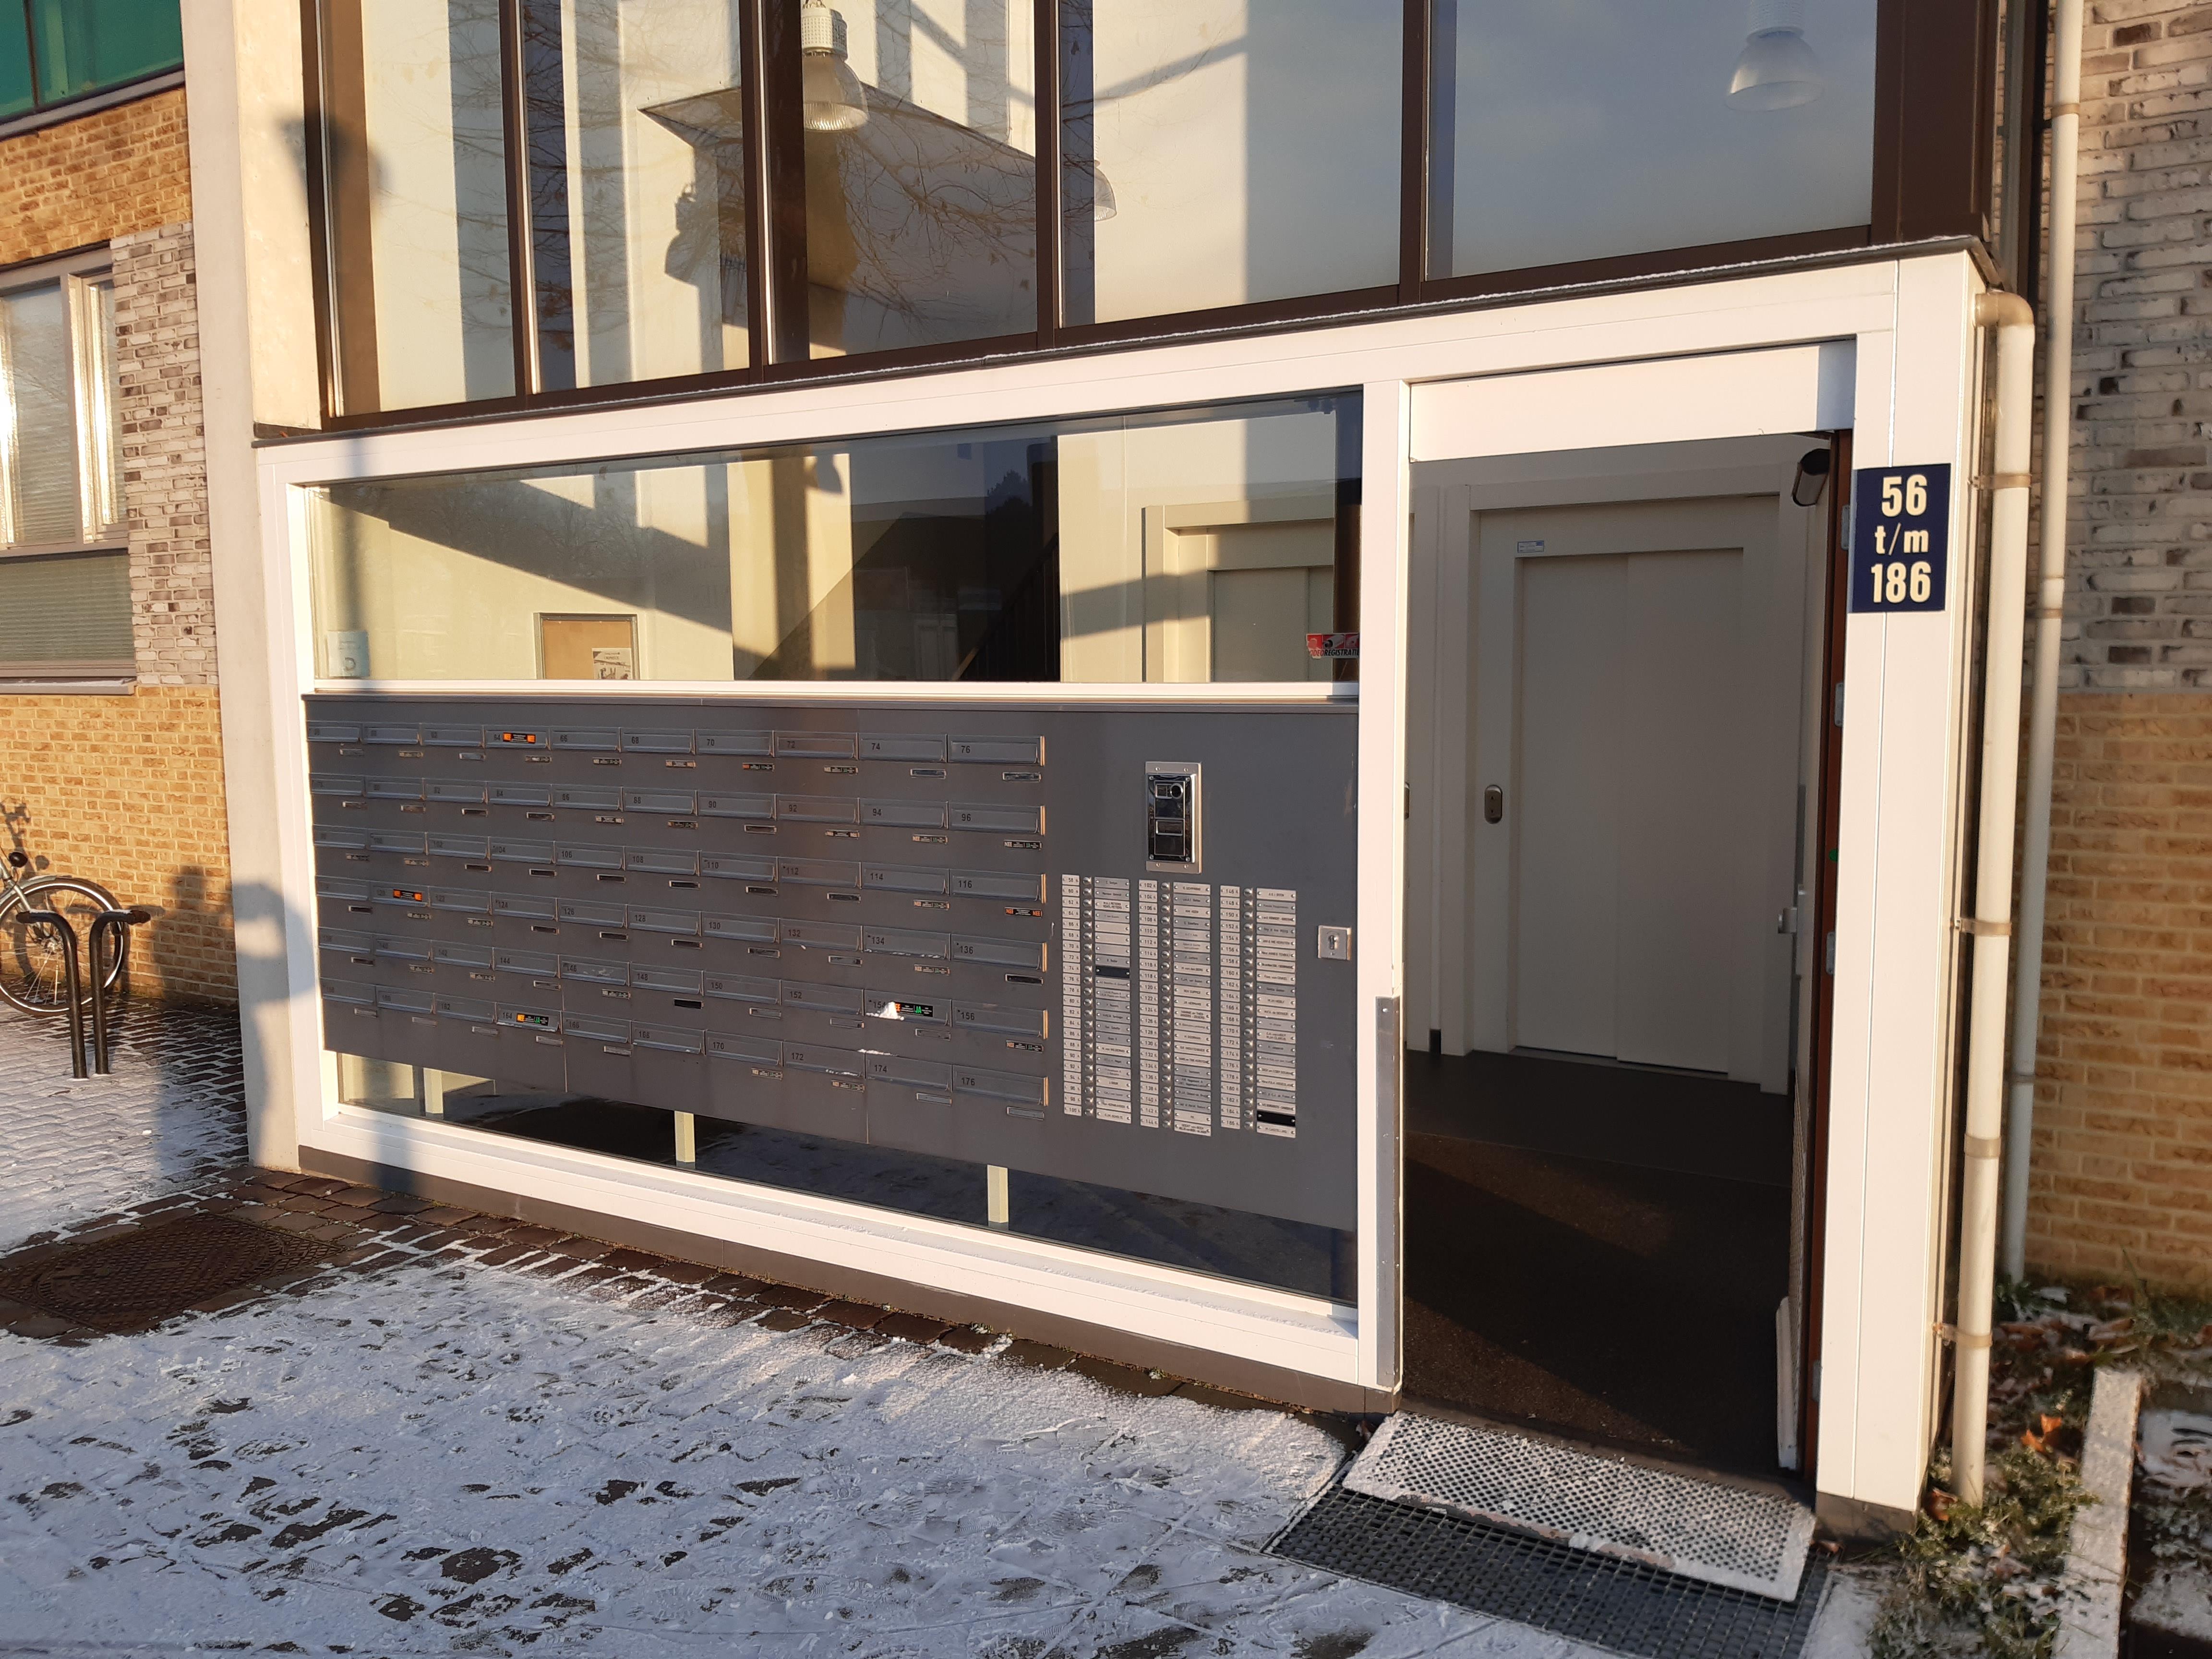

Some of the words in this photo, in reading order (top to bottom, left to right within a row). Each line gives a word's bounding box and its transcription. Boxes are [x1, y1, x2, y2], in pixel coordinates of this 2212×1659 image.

[1881, 473, 1928, 517] 56
[1874, 522, 1929, 556] t/m
[1870, 561, 1932, 603] 186
[961, 745, 971, 754] 76
[872, 937, 885, 945] 134
[959, 946, 974, 954] 136
[915, 1006, 922, 1014] JA
[961, 1012, 975, 1020] 156
[874, 1065, 888, 1073] 174
[962, 1078, 975, 1086] 176
